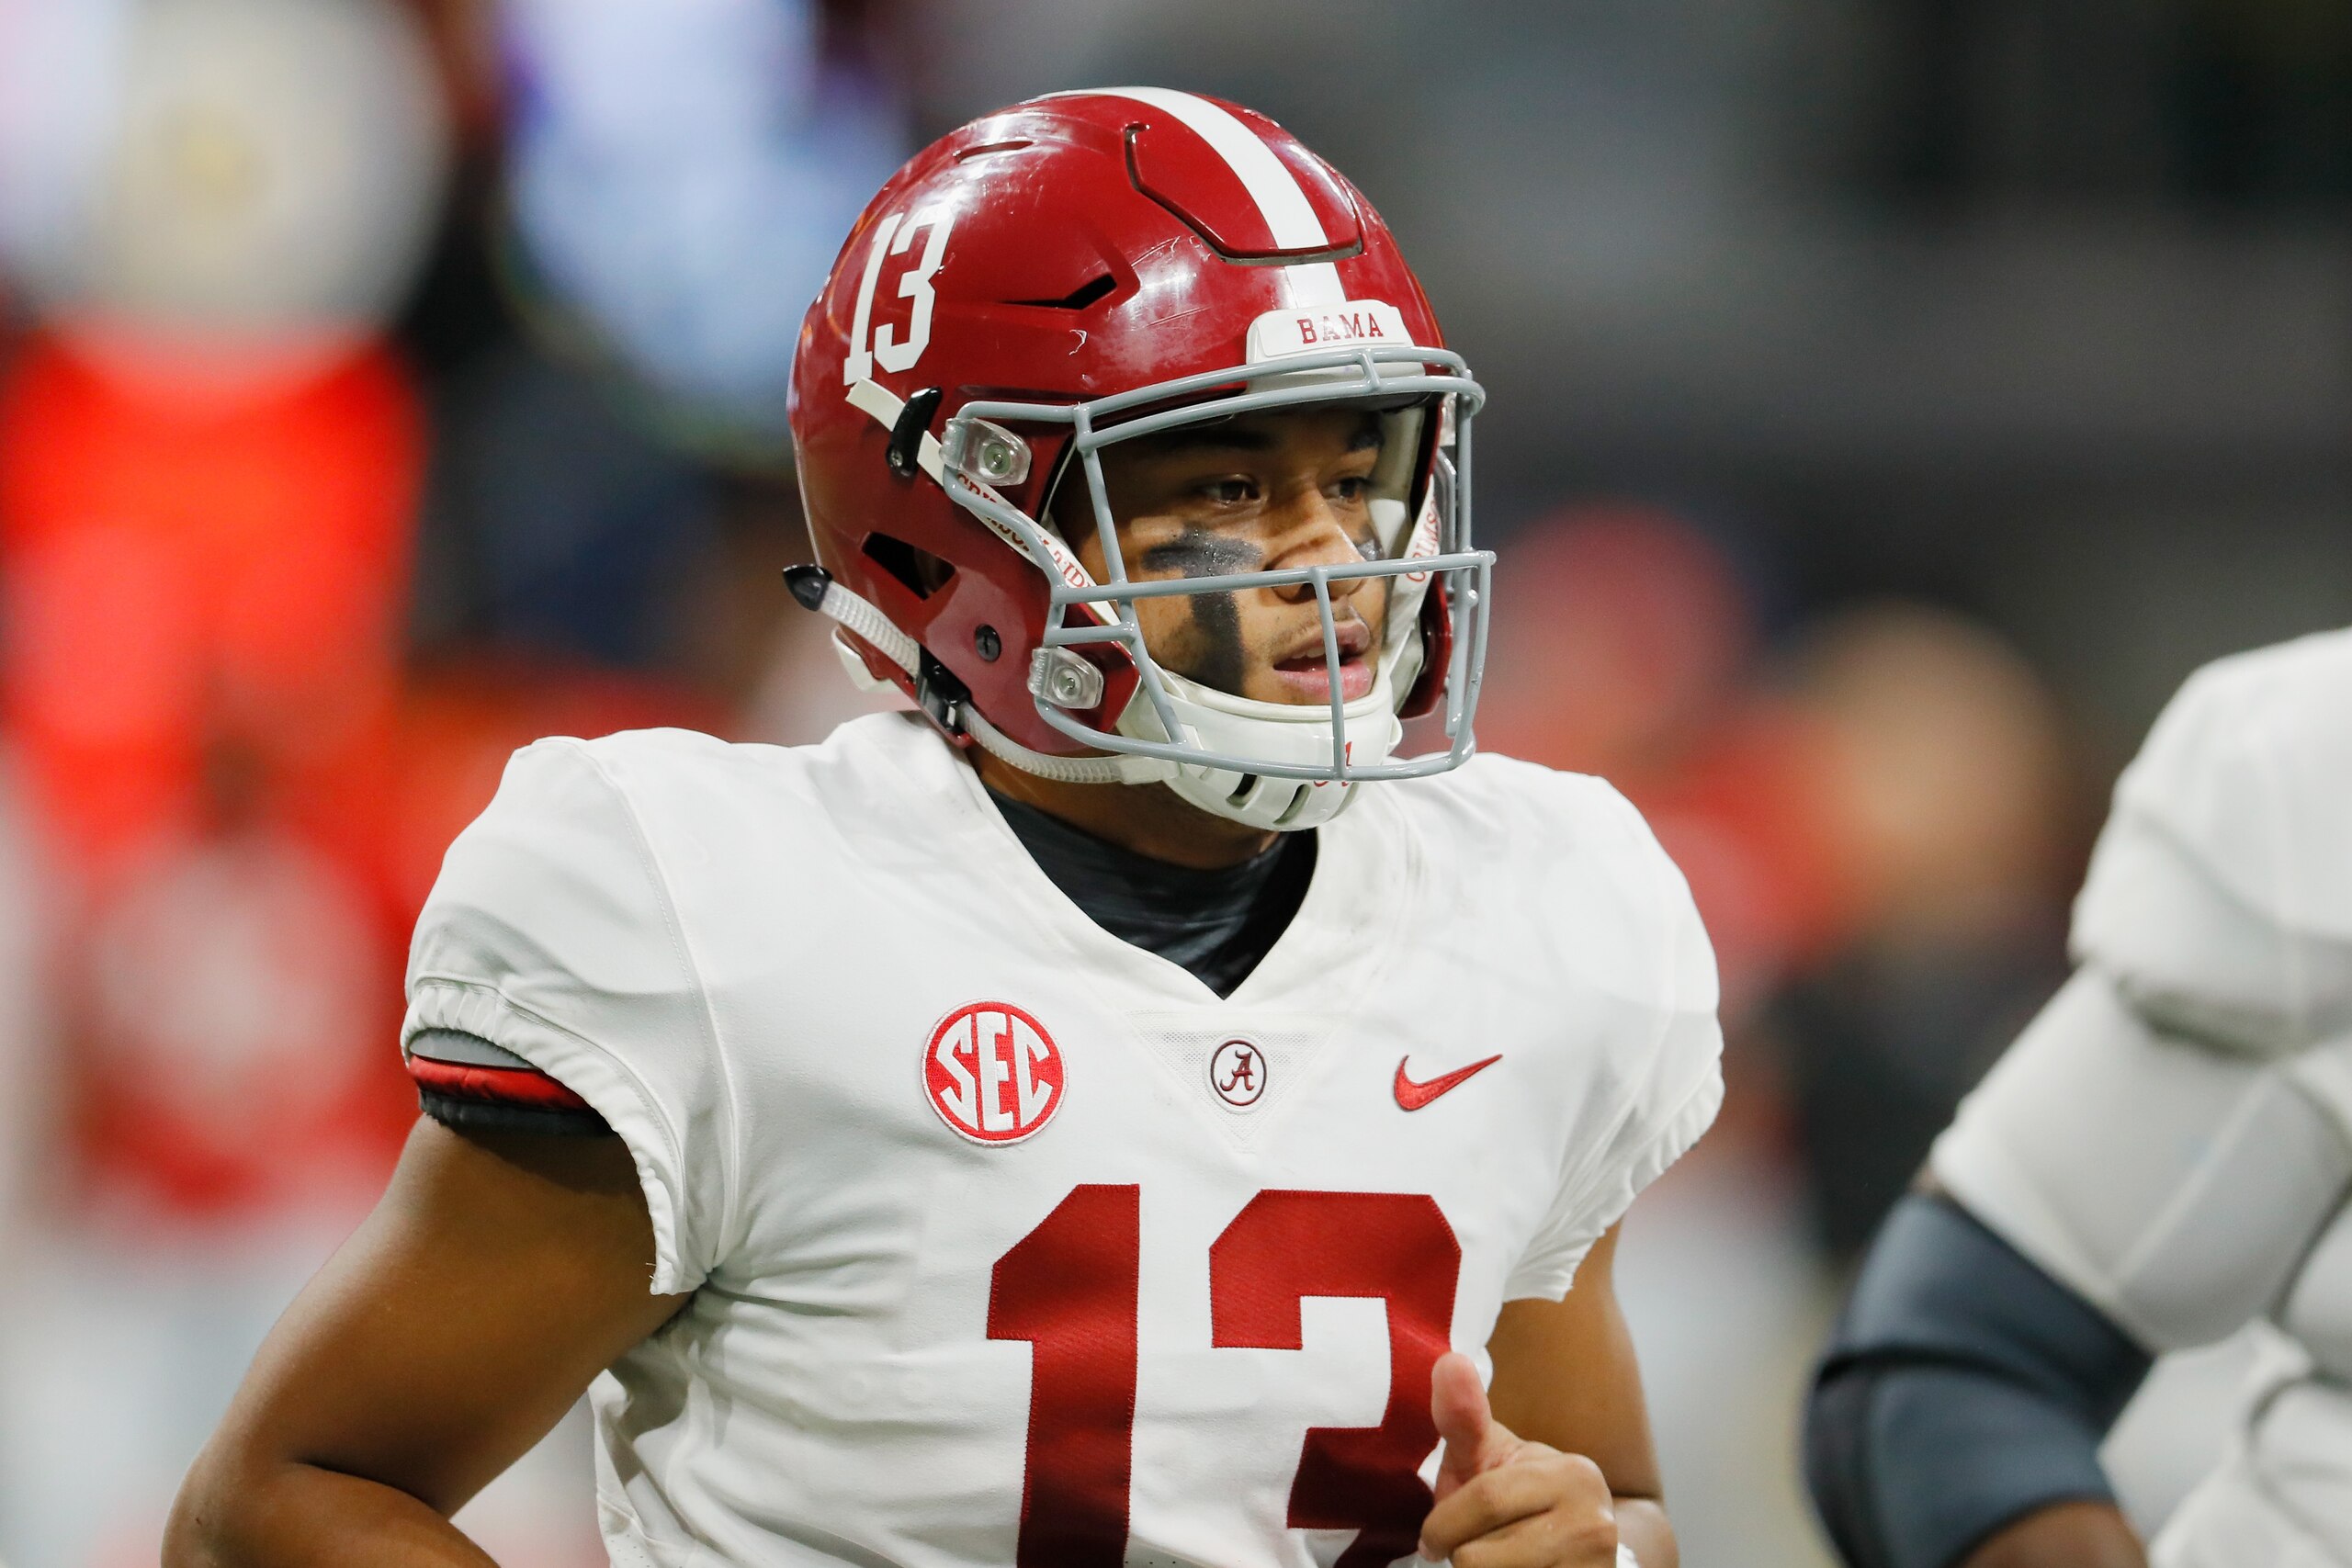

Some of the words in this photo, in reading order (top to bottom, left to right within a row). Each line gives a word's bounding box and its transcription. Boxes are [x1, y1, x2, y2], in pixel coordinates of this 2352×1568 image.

[843, 203, 956, 386] 13
[1296, 312, 1385, 344] BAMA
[937, 1010, 1053, 1132] SEC
[987, 1183, 1462, 1568] 13
